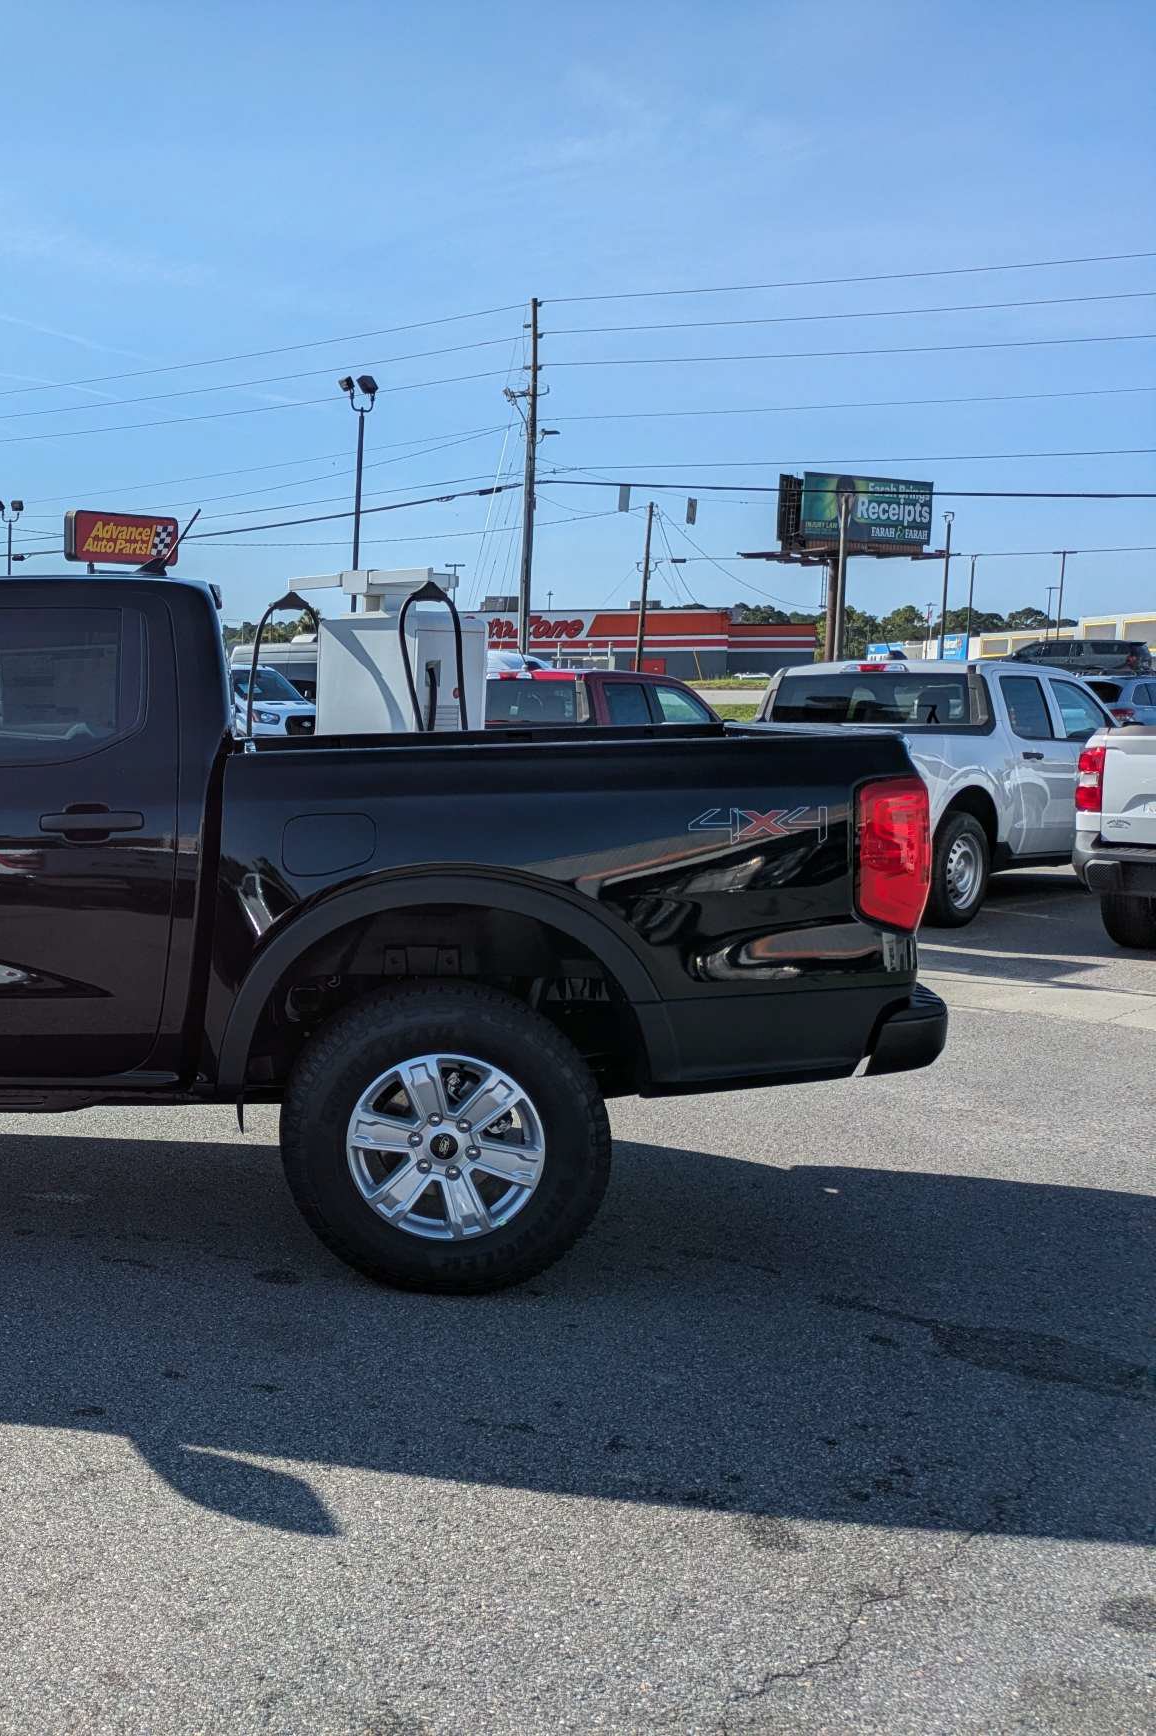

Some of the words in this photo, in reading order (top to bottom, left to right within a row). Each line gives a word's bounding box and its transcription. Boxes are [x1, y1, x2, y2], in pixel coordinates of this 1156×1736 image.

[868, 482, 897, 498] Farah
[857, 495, 930, 527] Receipts
[90, 520, 152, 541] Advance
[871, 526, 895, 538] FARAH
[904, 529, 928, 540] FARAH
[82, 537, 115, 553] Auto
[115, 539, 148, 555] Parts
